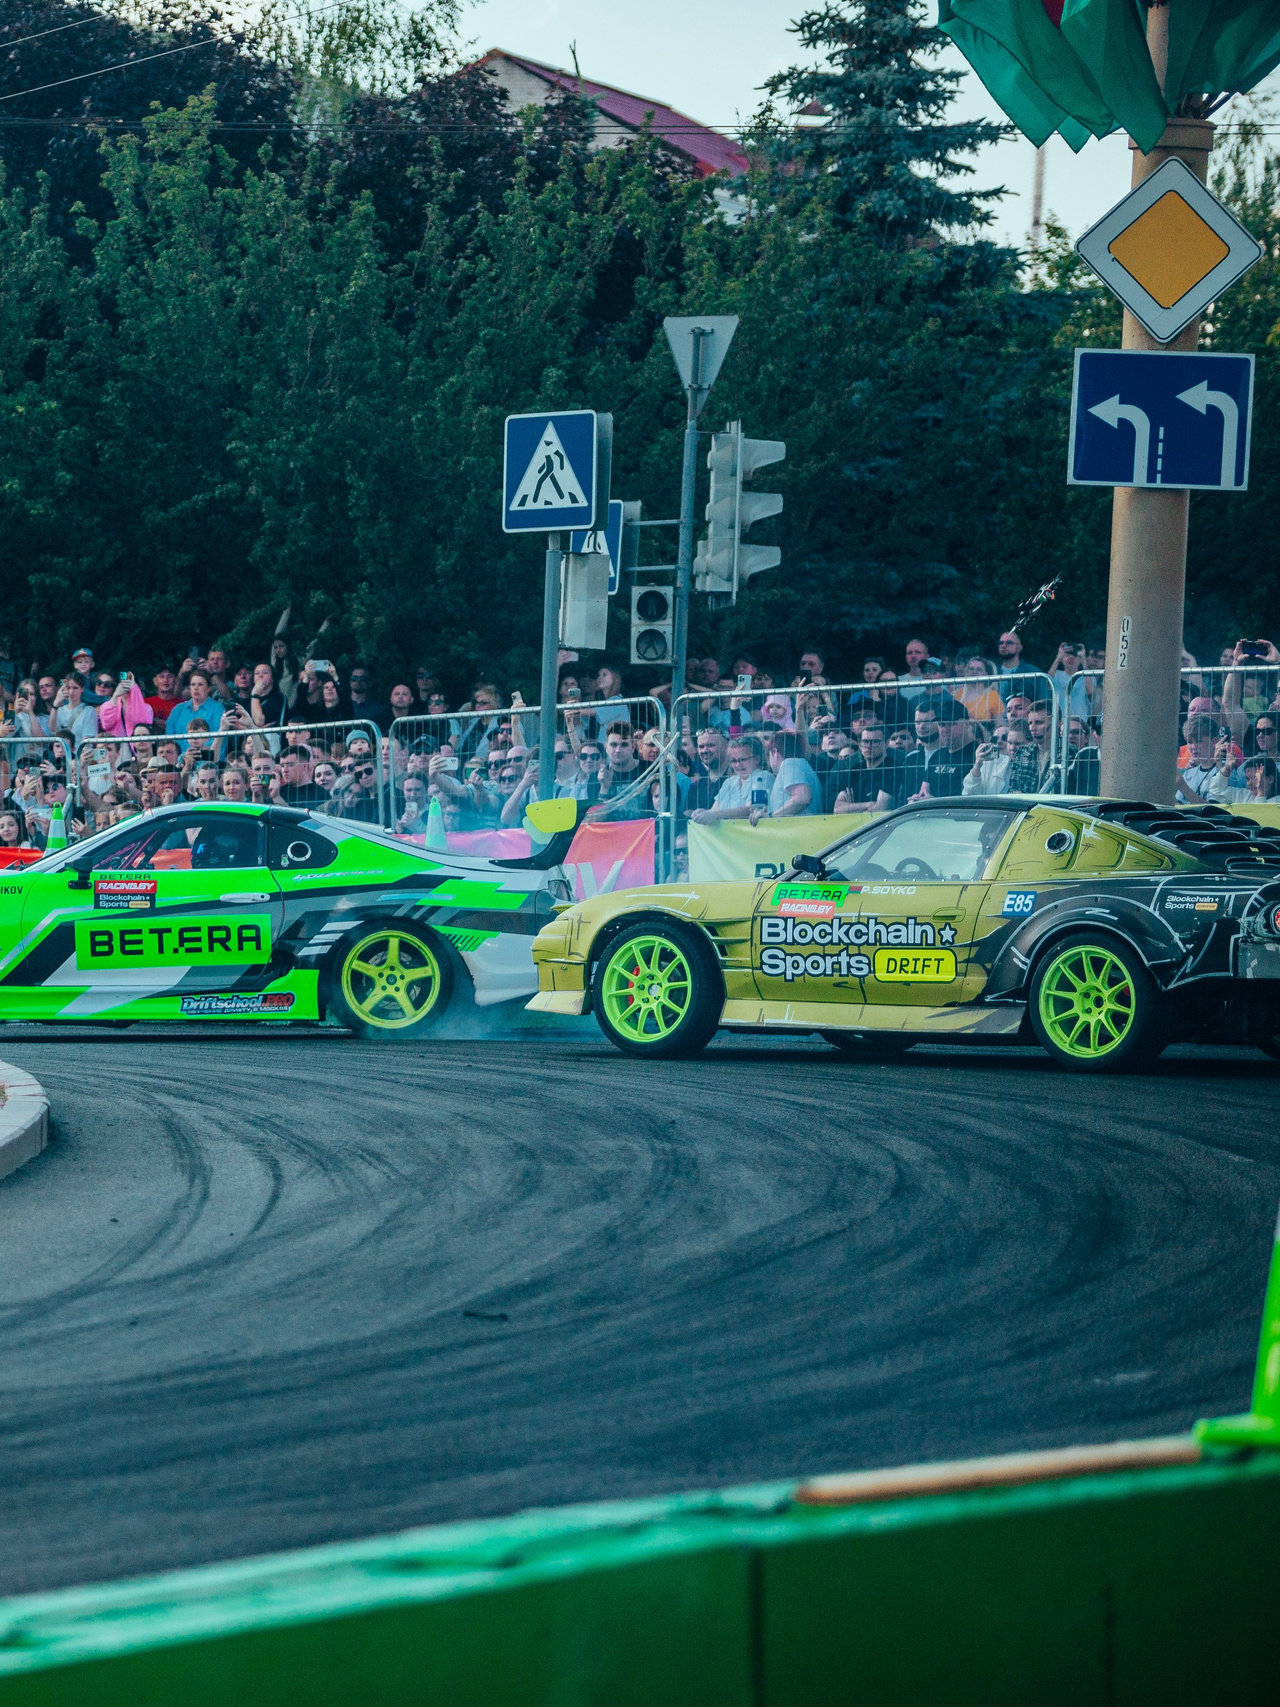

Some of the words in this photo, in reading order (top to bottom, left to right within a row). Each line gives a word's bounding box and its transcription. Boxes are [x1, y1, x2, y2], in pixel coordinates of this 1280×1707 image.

[1120, 618, 1130, 668] 052
[98, 882, 154, 890] RACING.BY
[1003, 894, 1035, 912] E85
[1165, 902, 1194, 910] Sports
[761, 917, 935, 945] Blockchain
[761, 948, 870, 980] Sports
[885, 957, 945, 975] DRIFT
